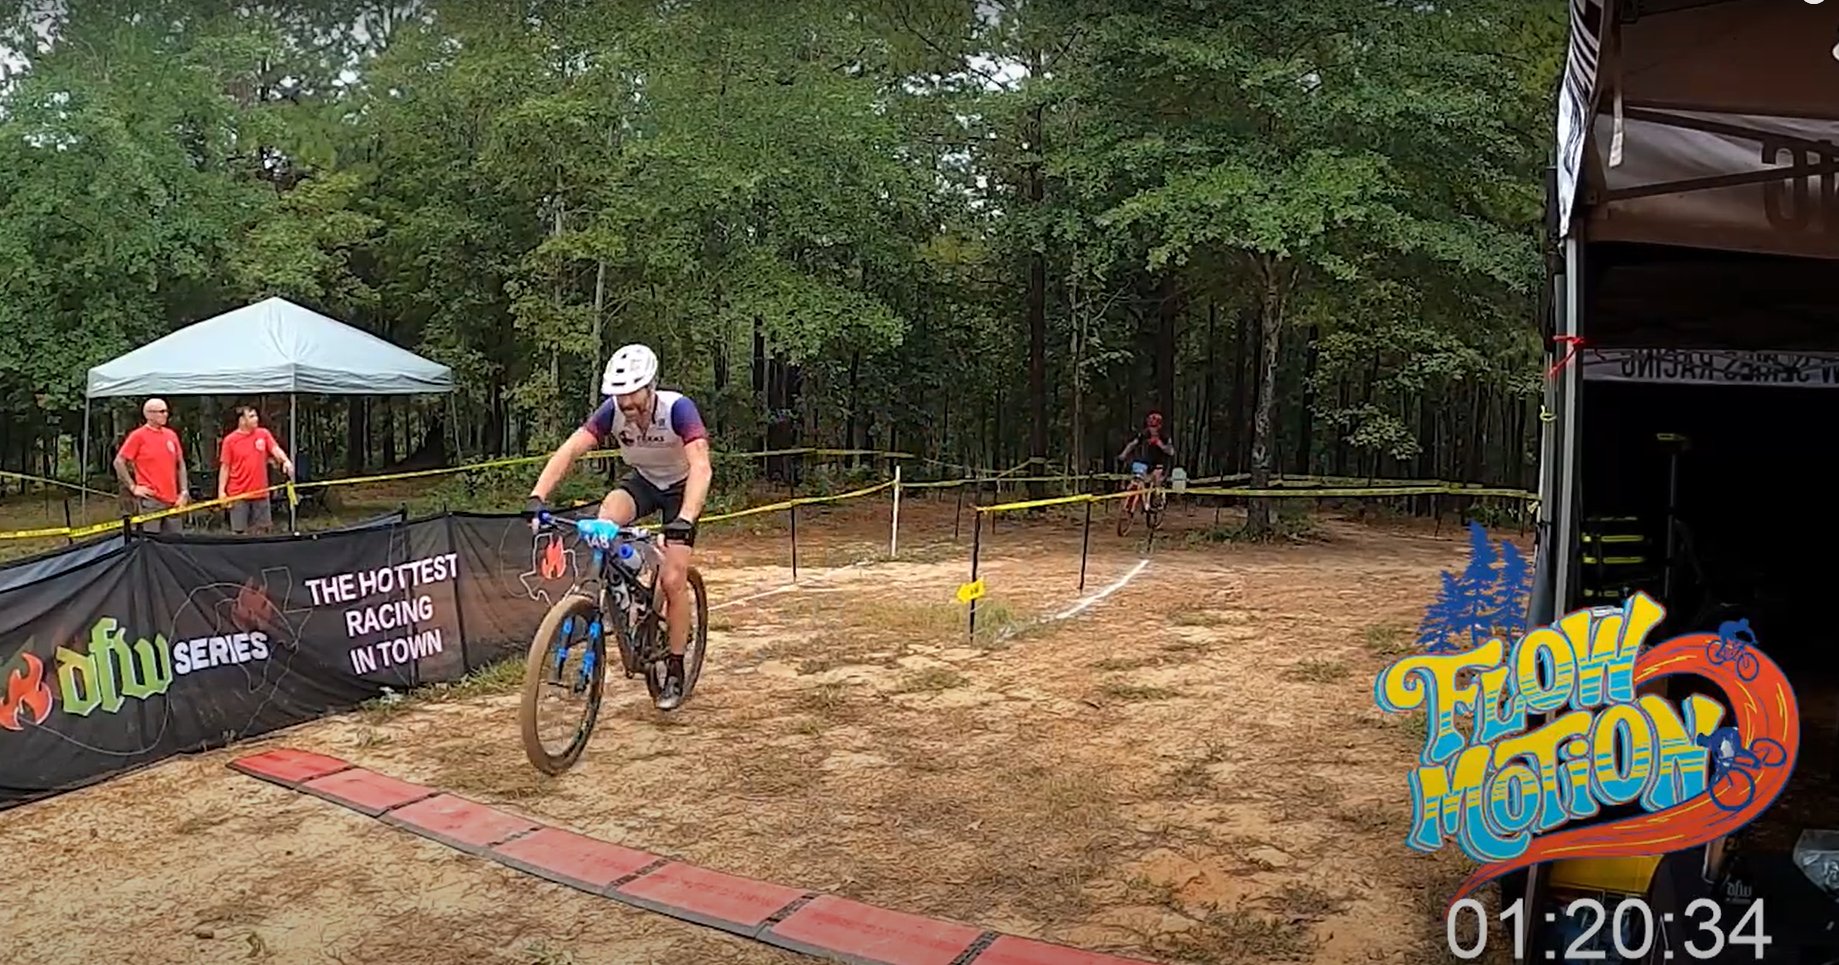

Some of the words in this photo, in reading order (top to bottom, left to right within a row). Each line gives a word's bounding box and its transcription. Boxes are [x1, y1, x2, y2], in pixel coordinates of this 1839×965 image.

[584, 533, 610, 549] 148
[305, 572, 356, 607] THE
[358, 553, 458, 595] HOTTEST
[344, 596, 433, 638] RACING
[173, 631, 269, 675] SERIES
[350, 647, 377, 675] IN
[377, 629, 443, 667] TOWN
